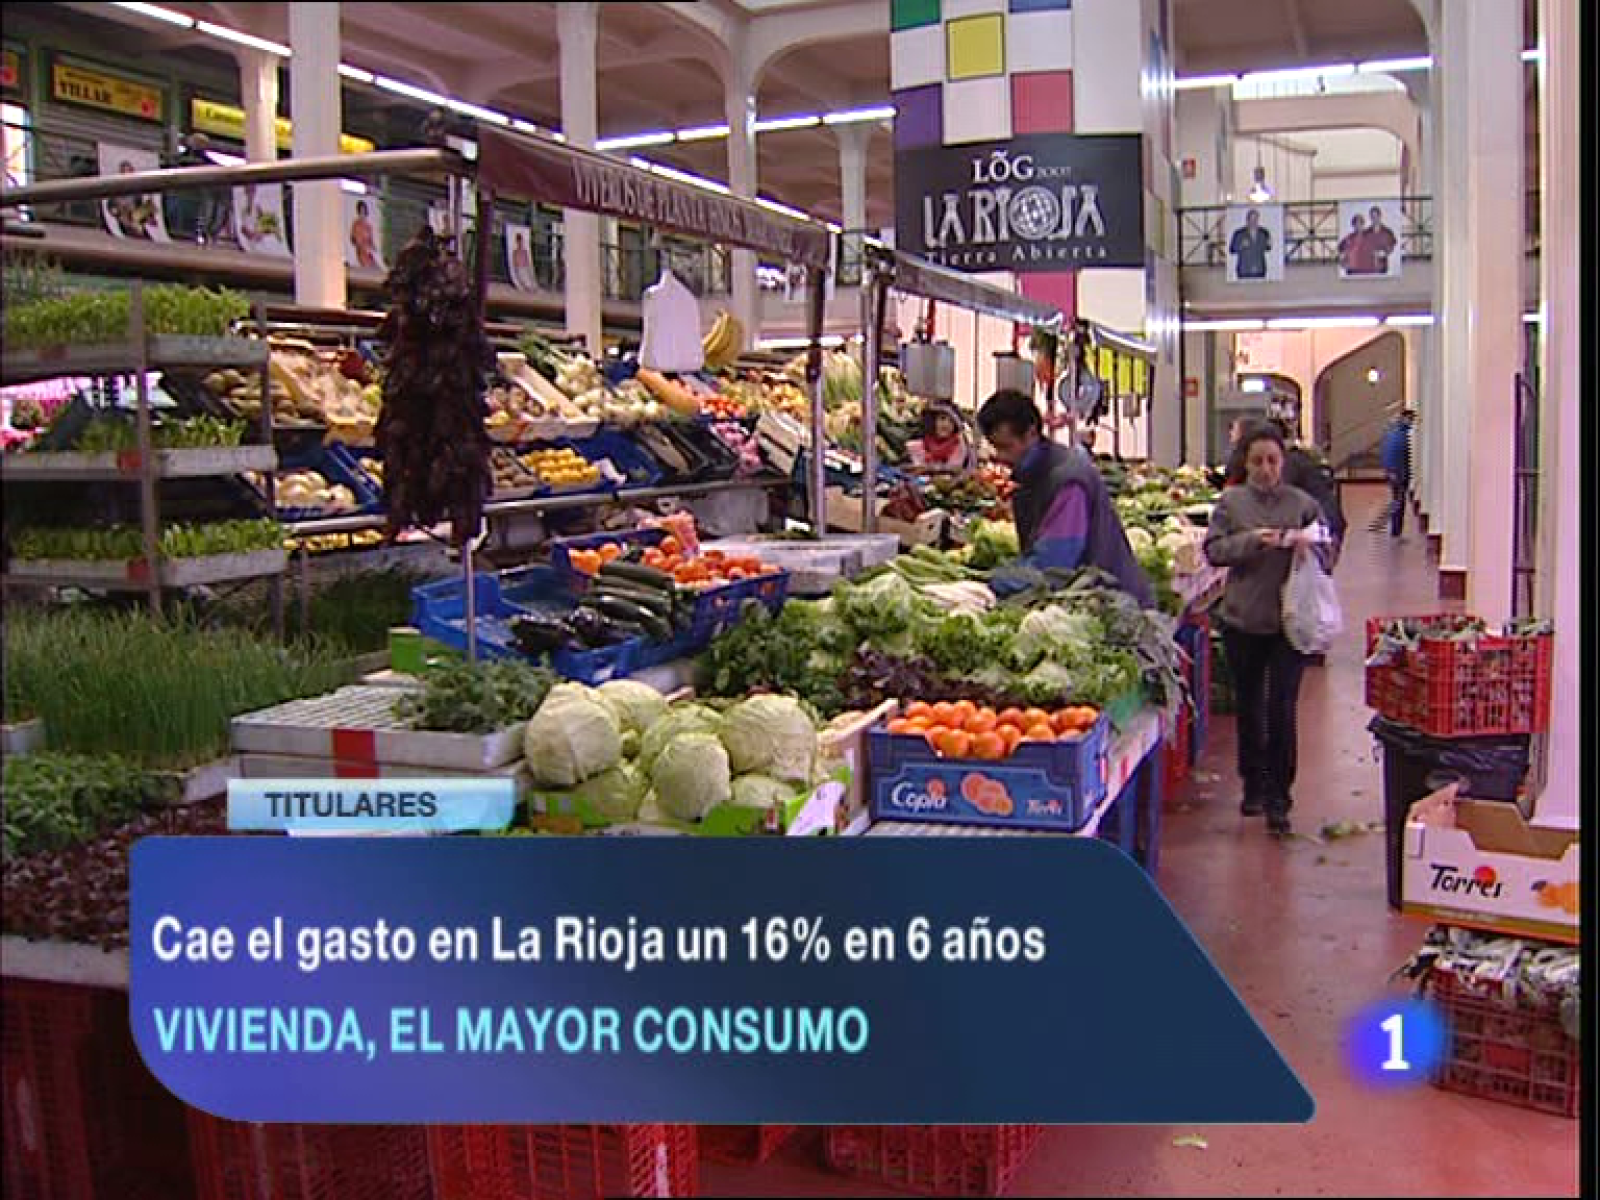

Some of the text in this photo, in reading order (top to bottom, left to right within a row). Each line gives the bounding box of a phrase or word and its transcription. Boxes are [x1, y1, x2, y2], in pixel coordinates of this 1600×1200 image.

[923, 184, 1105, 248] LA RIOJA
[925, 245, 1106, 265] Tierra Abierta
